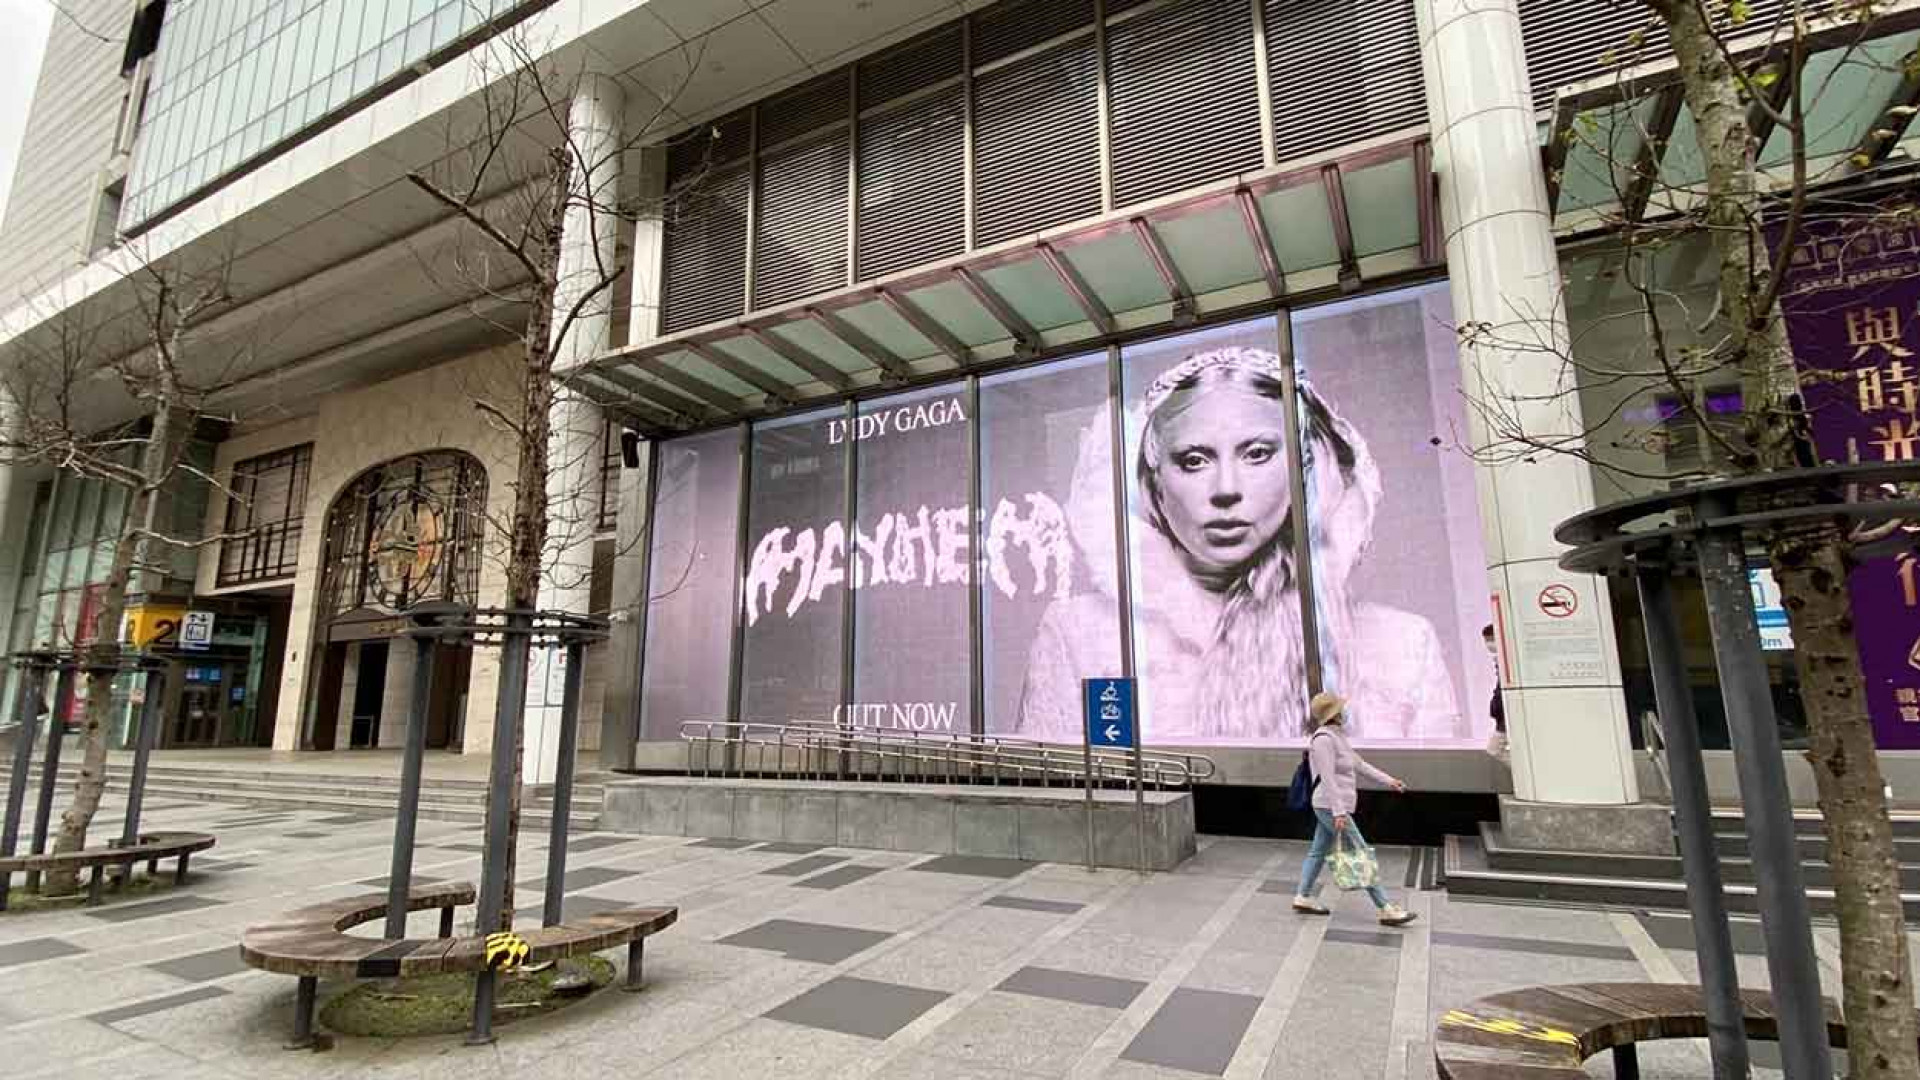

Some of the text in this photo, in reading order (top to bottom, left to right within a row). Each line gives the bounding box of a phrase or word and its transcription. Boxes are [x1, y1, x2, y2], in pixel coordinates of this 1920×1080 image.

[894, 397, 966, 432] GAGA
[746, 492, 1072, 628] MAYHEM
[891, 701, 958, 730] NOW
